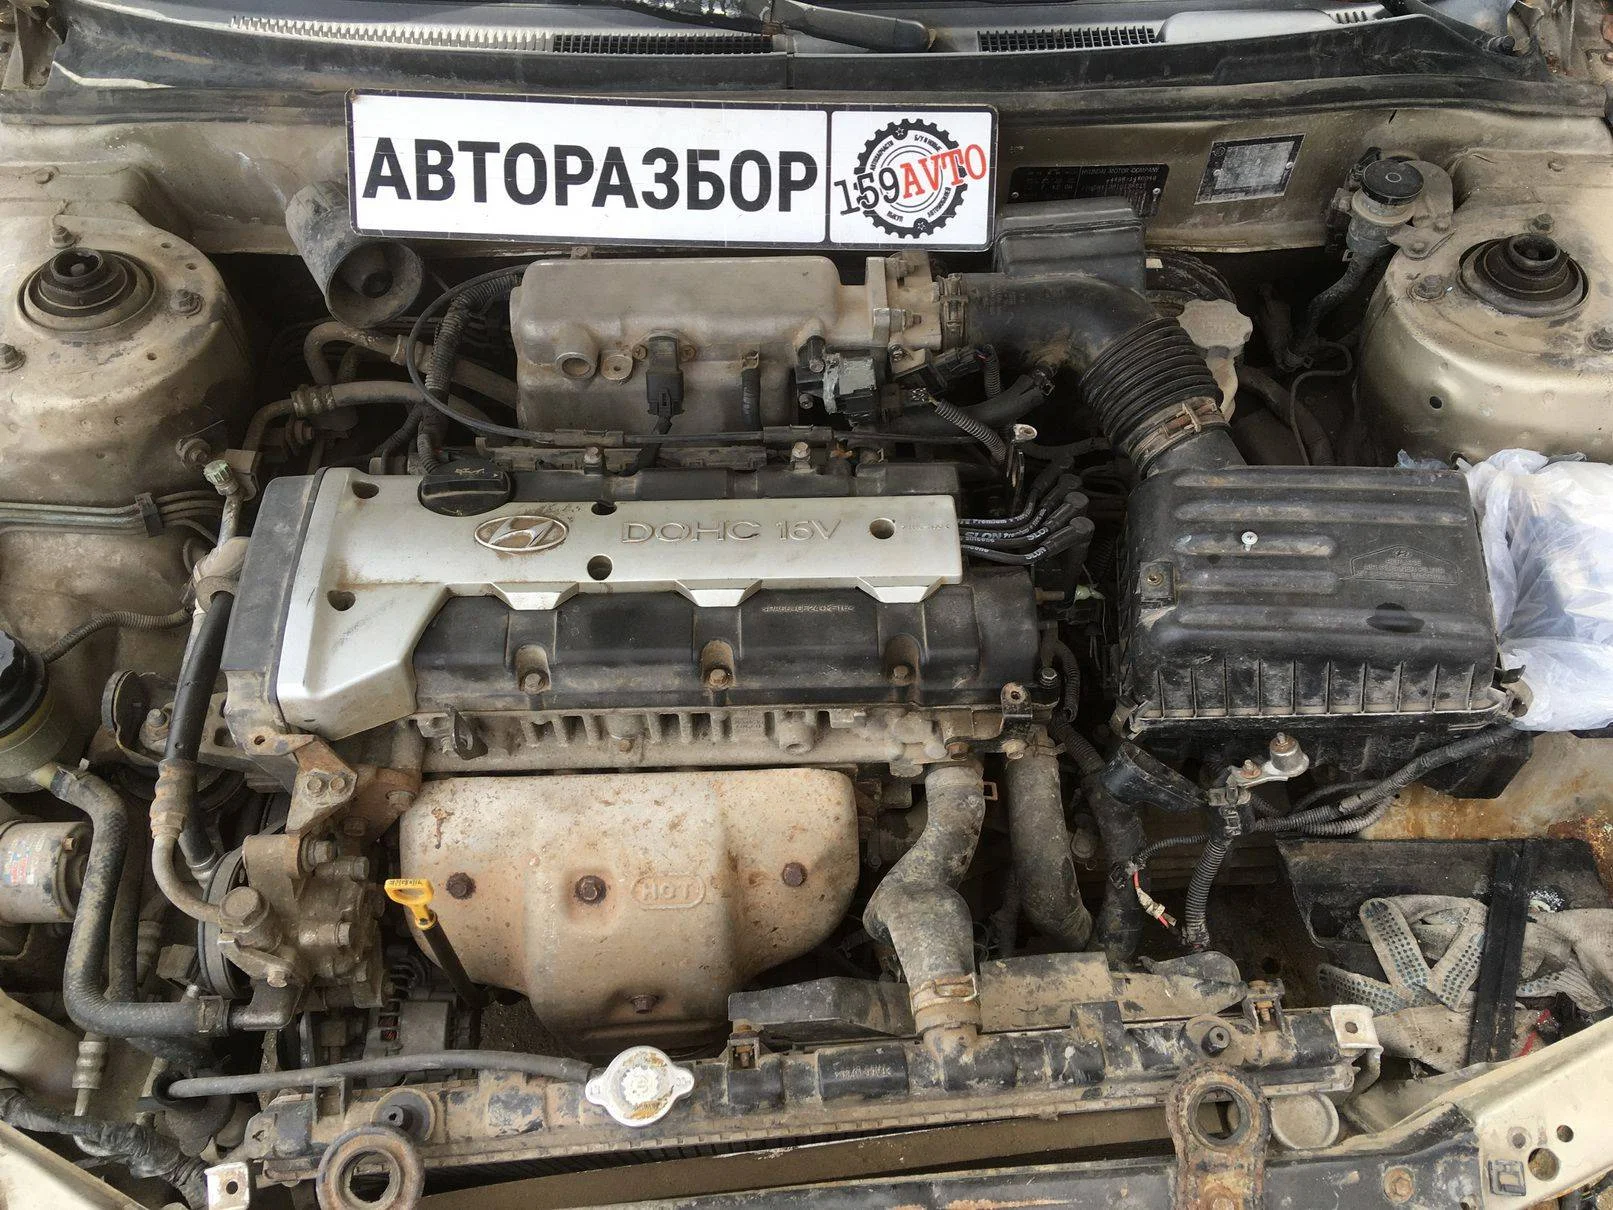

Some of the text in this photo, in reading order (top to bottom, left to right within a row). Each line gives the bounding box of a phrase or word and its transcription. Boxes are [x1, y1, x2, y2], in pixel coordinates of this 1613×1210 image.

[362, 137, 818, 213] АВТОРАЗБОР
[621, 518, 841, 543] DOHC 16V
[642, 881, 692, 901] HOT
